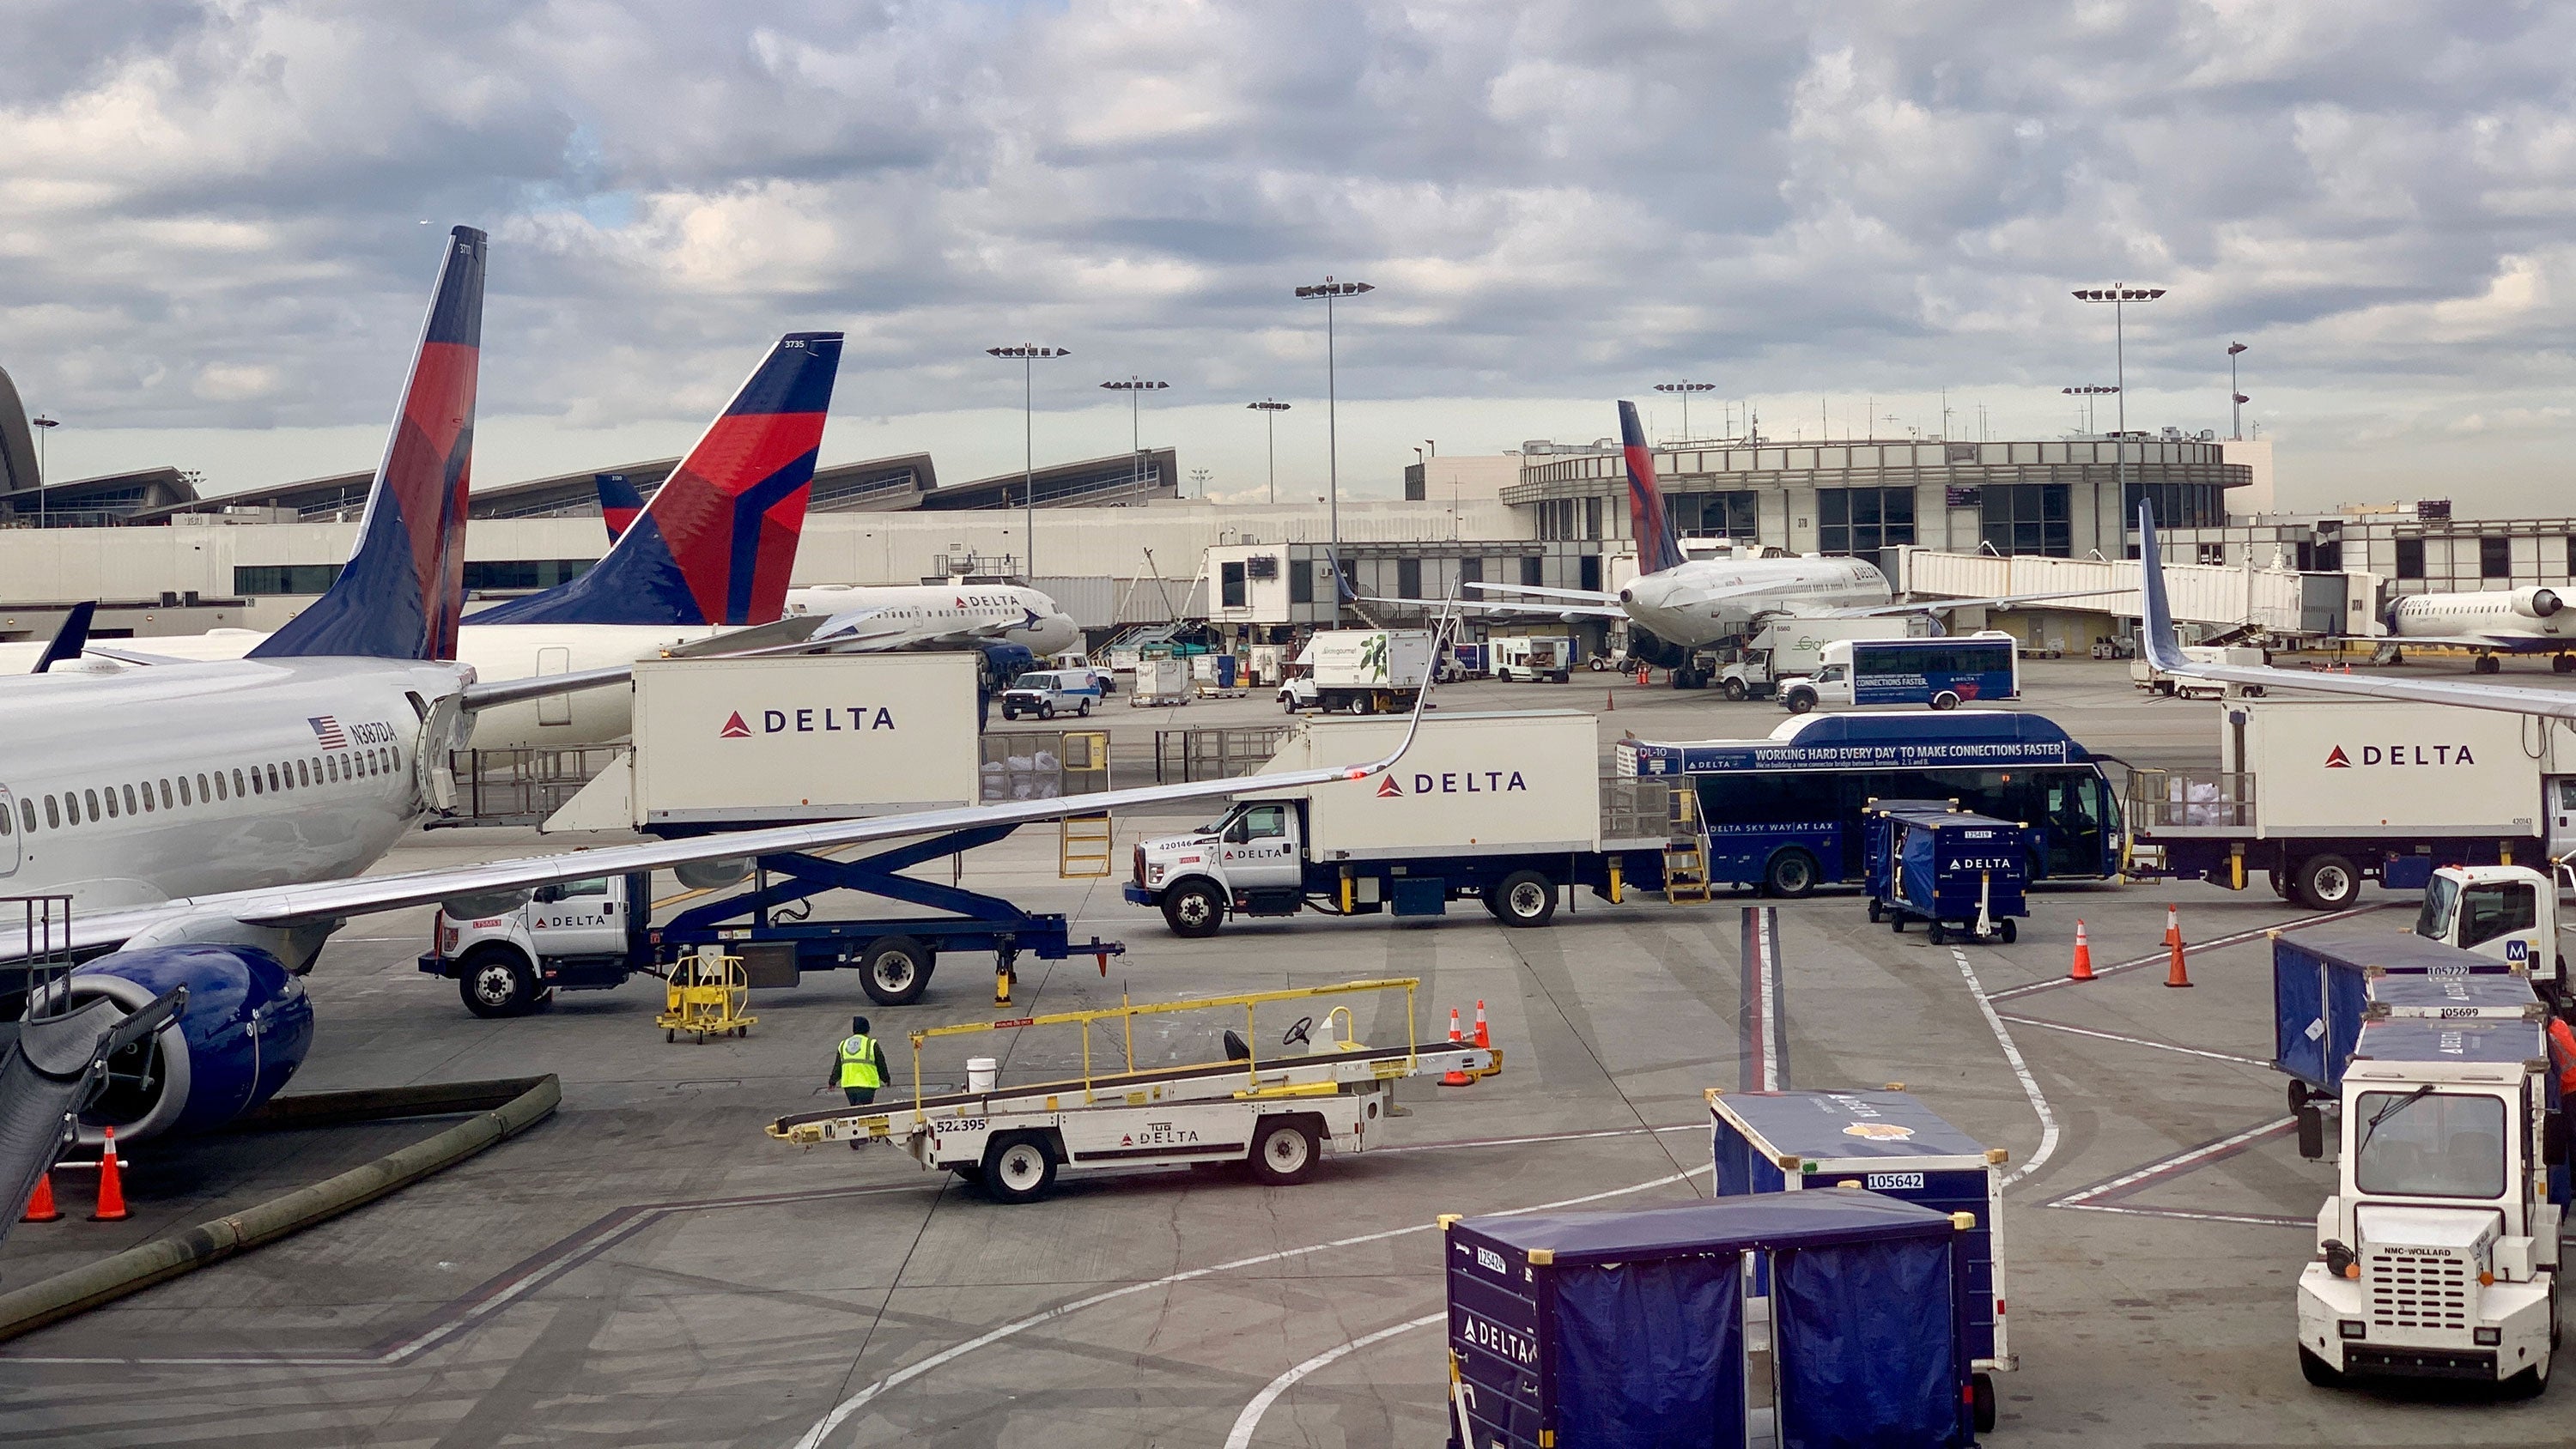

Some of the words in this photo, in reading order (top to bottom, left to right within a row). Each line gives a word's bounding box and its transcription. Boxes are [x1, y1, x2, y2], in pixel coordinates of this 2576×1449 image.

[785, 340, 805, 349] 3735
[969, 595, 1020, 607] DELTA
[764, 707, 896, 733] DELTA
[349, 721, 398, 746] N387DA
[1640, 748, 1668, 756] DL-10
[1754, 749, 1806, 761] WORKING
[1808, 748, 1838, 760] HARD
[1840, 747, 1873, 760] EVERY
[1875, 747, 1897, 759] DAY
[1900, 746, 1915, 757] TO
[1917, 745, 1947, 757] MAKE
[1949, 744, 2022, 757] CONNECTIONS
[2363, 745, 2475, 766] DELTA
[1415, 771, 1527, 794] DELTA
[1769, 823, 1792, 832] WAY
[1159, 840, 1192, 851] 420146
[1237, 849, 1282, 858] DELTA
[1965, 858, 2010, 869] DELTA
[552, 915, 605, 927] DELTA
[2509, 944, 2524, 958] M
[2440, 1008, 2479, 1017] 105699
[936, 1119, 986, 1133] 522395
[1140, 1130, 1199, 1144] DELTA
[1869, 1175, 1922, 1189] 105642
[2385, 1246, 2451, 1257] NMC-WOLLARD
[1479, 1250, 1504, 1271] 125424
[1479, 1321, 1528, 1364] DELTA
